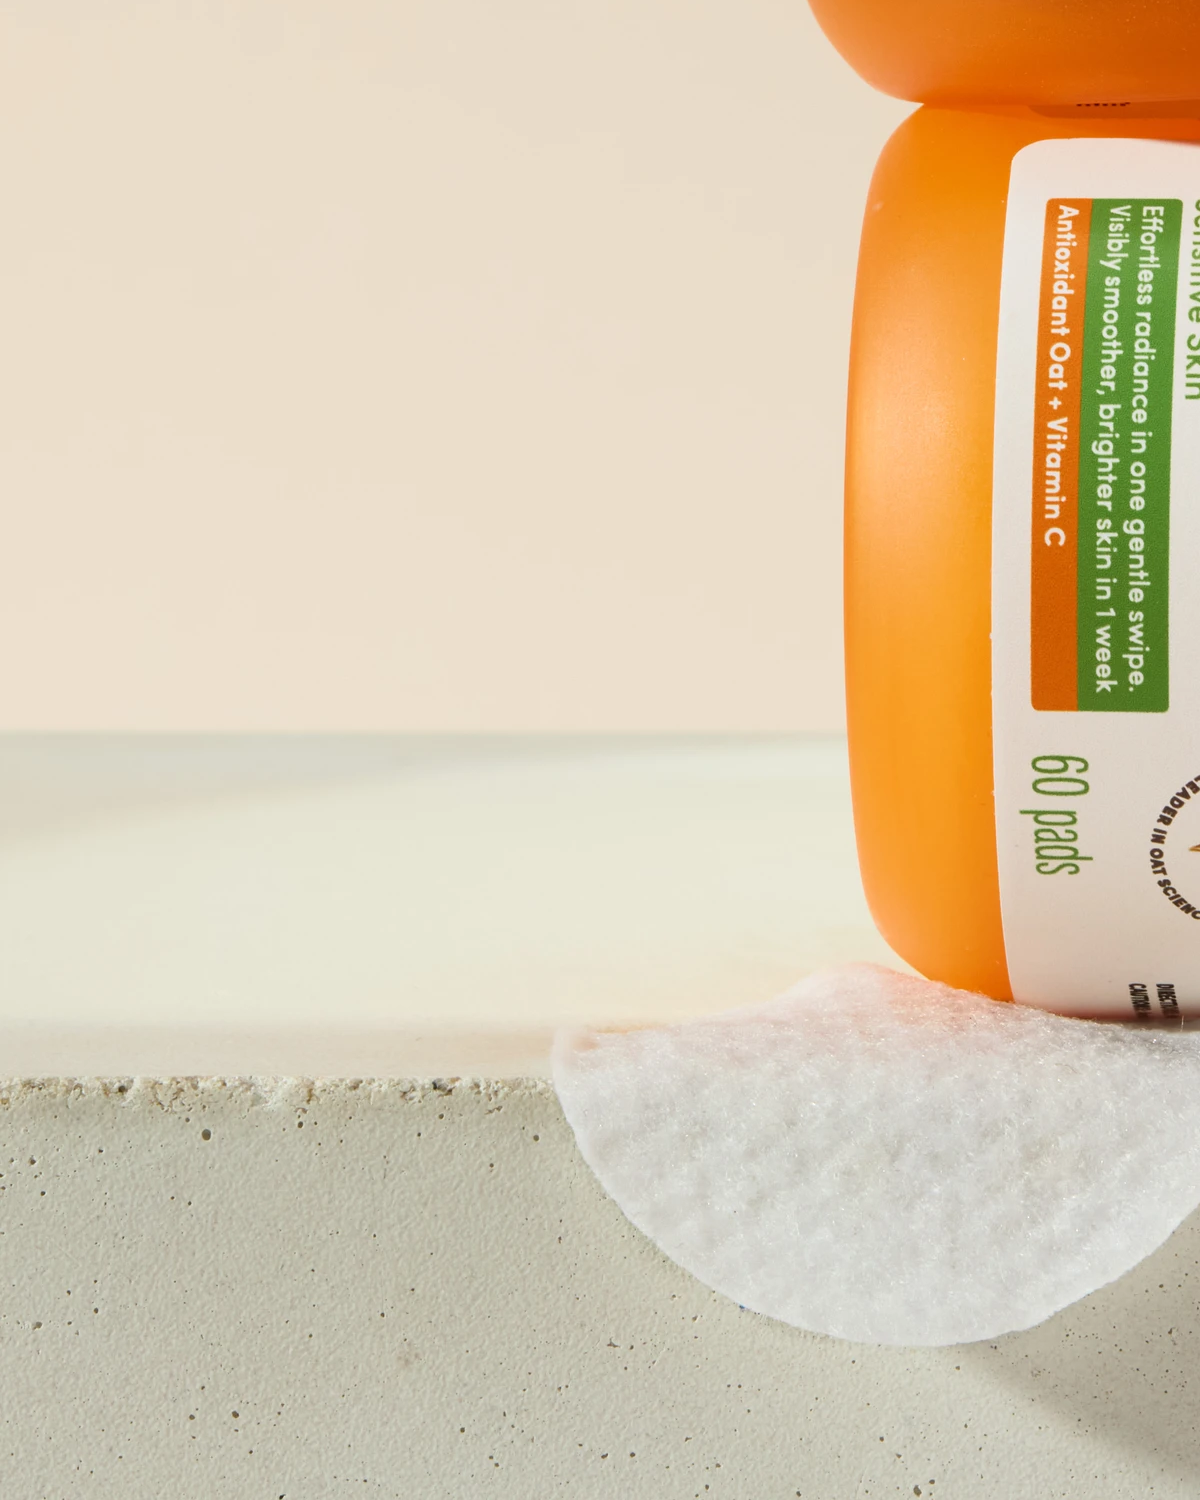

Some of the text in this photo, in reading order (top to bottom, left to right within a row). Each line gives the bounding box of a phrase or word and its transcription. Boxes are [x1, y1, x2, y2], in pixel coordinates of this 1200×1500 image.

[1044, 204, 1080, 547] Antioxidant Oat + Vitamin C
[1091, 204, 1131, 694] Visibly smoother, brighter skin in 1 week
[1122, 204, 1165, 692] Effortless radiance in one gentle swipe.
[1019, 755, 1093, 875] 60 pads
[1150, 848, 1167, 876] OAT
[1151, 828, 1167, 844] IN
